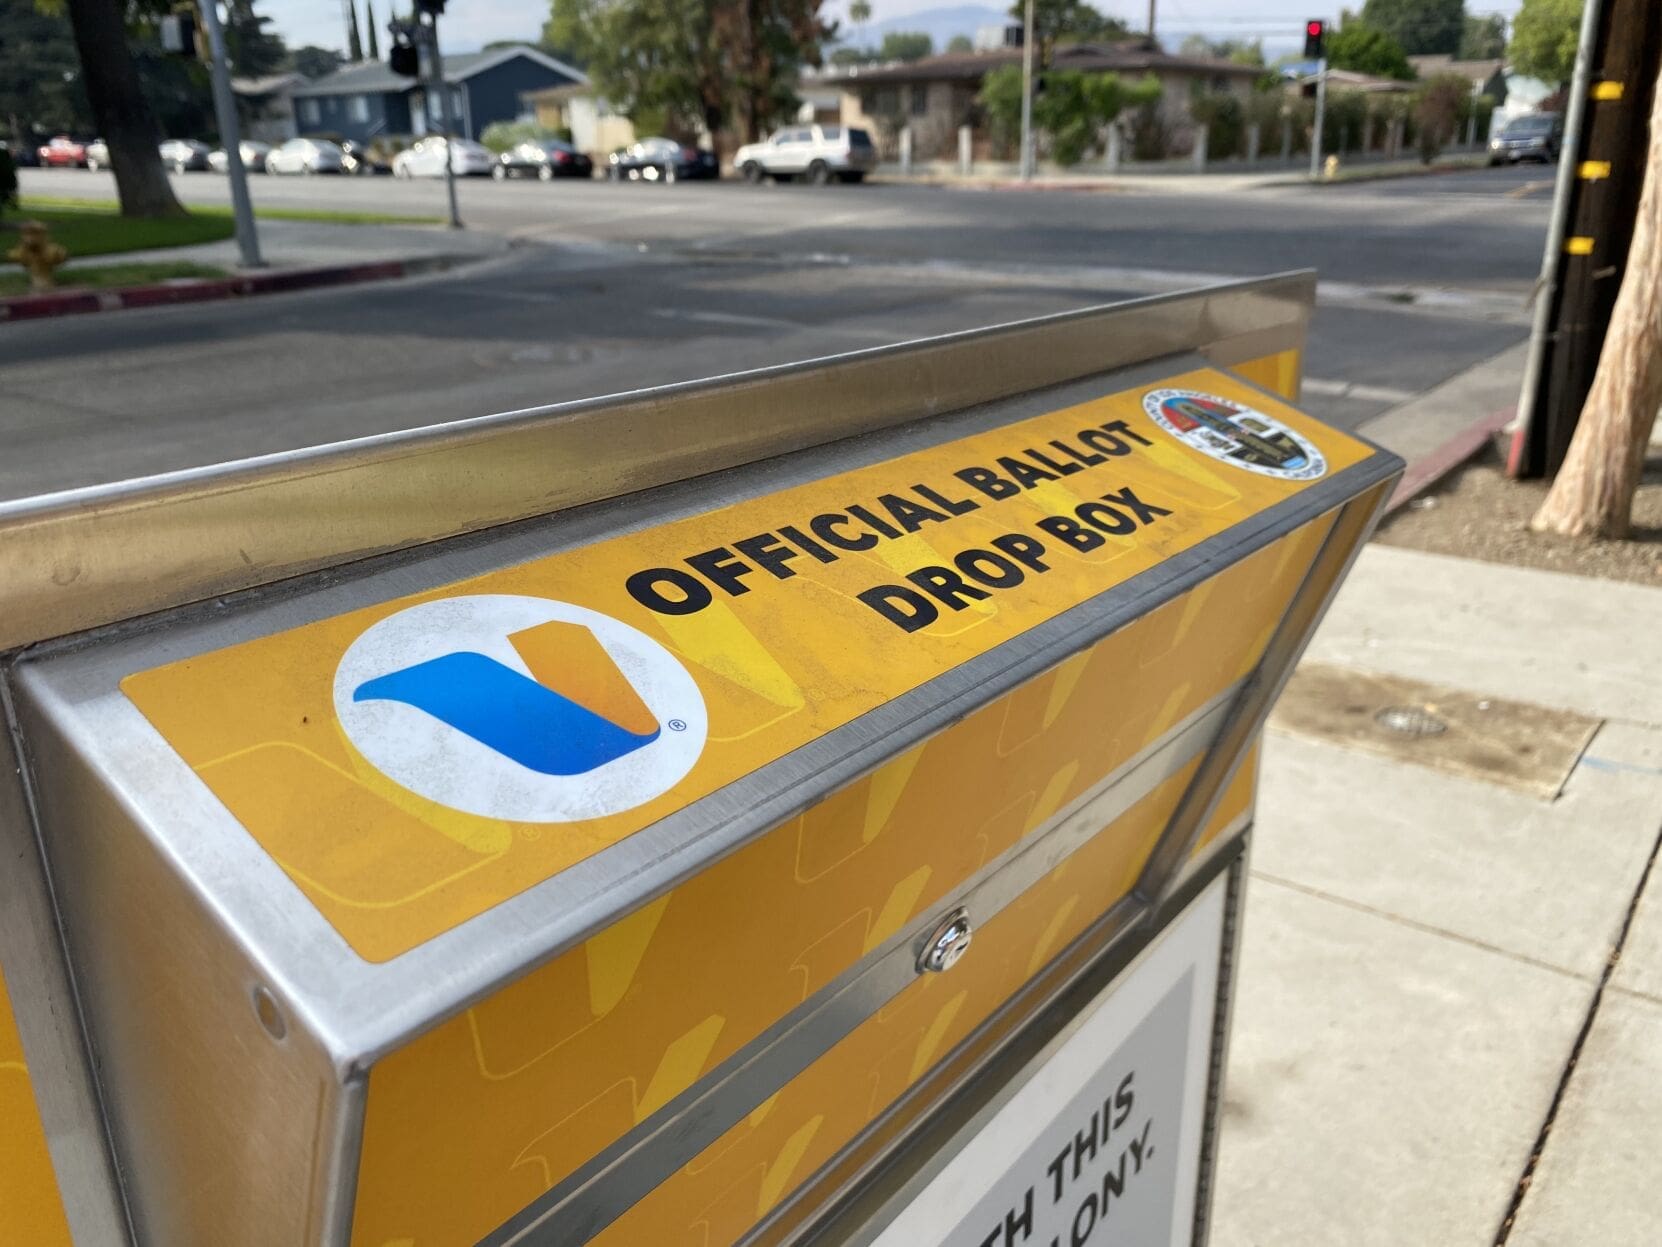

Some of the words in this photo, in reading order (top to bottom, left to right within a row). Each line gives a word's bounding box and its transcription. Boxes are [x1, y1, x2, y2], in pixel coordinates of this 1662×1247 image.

[626, 484, 980, 616] OFFICIAL
[954, 420, 1153, 501] BALLOT
[857, 533, 1050, 633] DROP
[1036, 487, 1173, 553] BOX
[1047, 1071, 1134, 1204] THIS
[1051, 1118, 1154, 1247] ONY.
